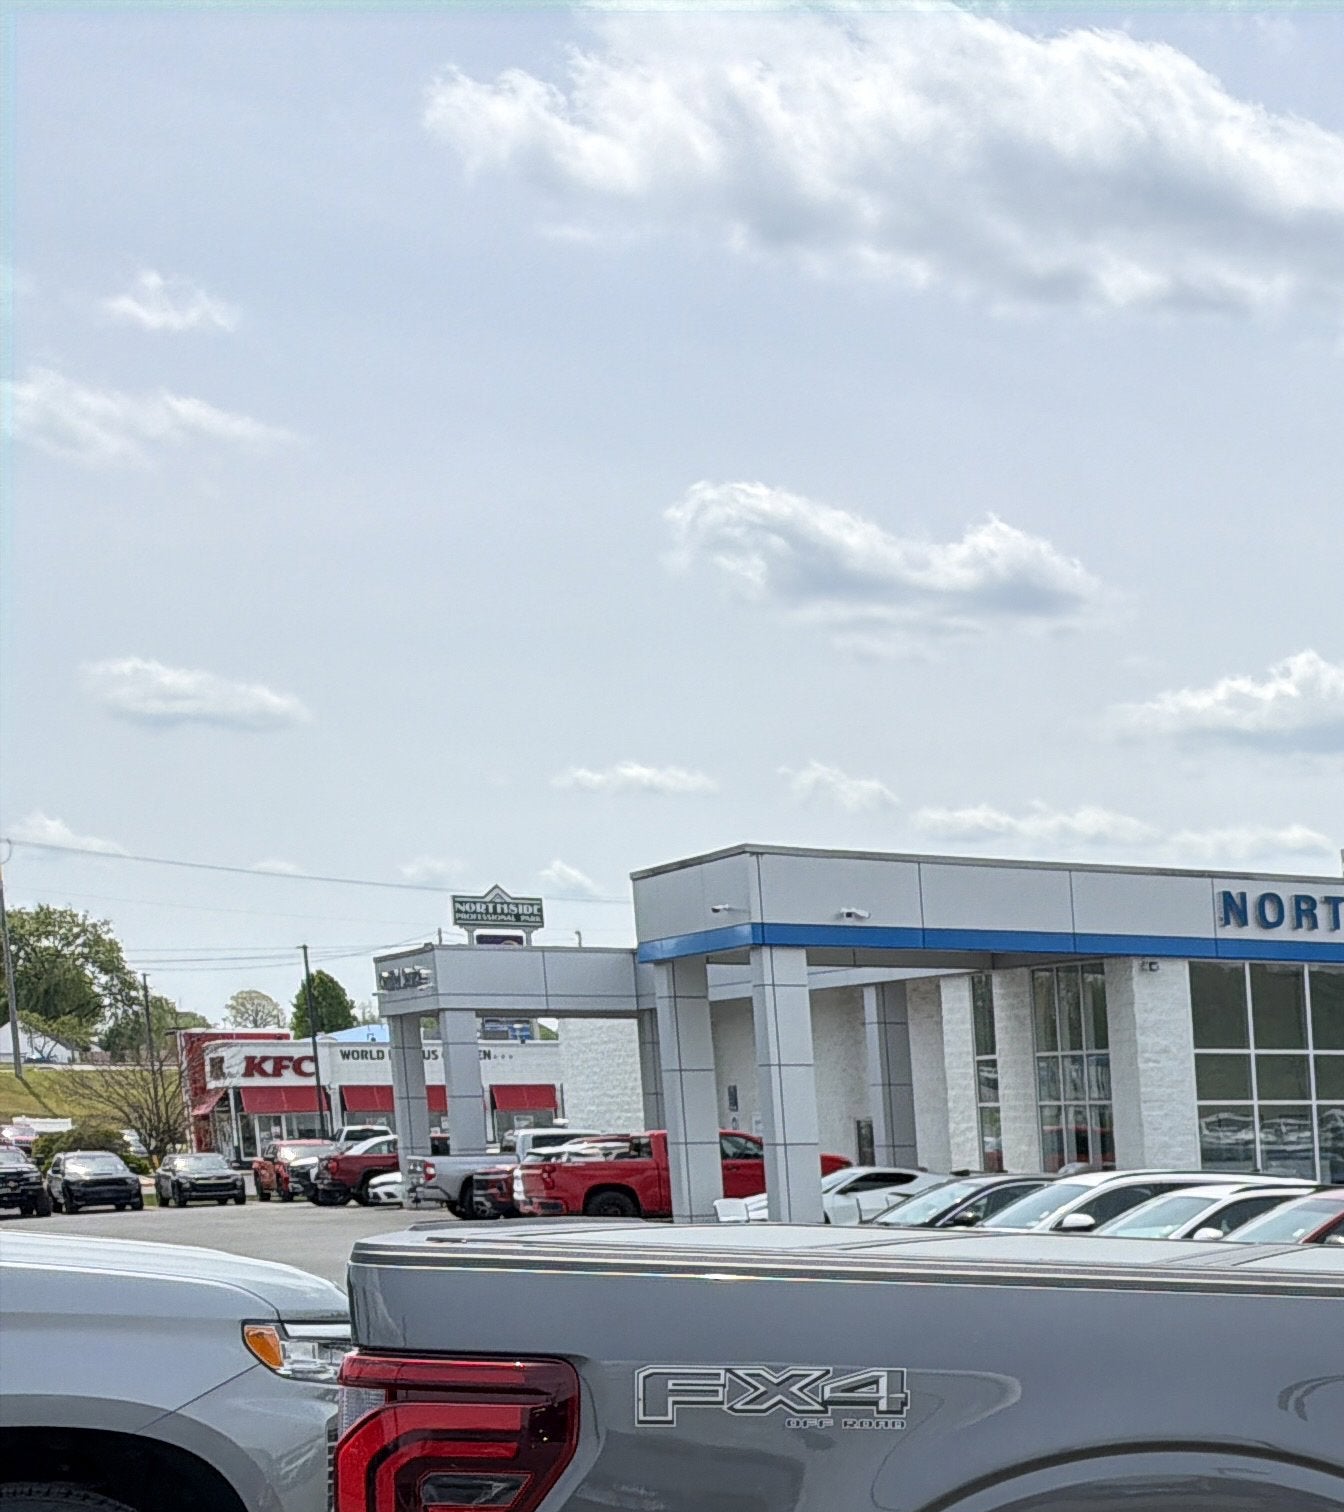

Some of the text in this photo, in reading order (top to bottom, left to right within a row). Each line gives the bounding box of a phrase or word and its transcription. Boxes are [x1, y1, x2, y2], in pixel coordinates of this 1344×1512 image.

[454, 902, 541, 914] NORTHSIDE
[340, 1050, 385, 1060] WORLD
[241, 1055, 316, 1078] KFC
[635, 1365, 910, 1427] FX4
[785, 1418, 906, 1430] OFF ROAD
